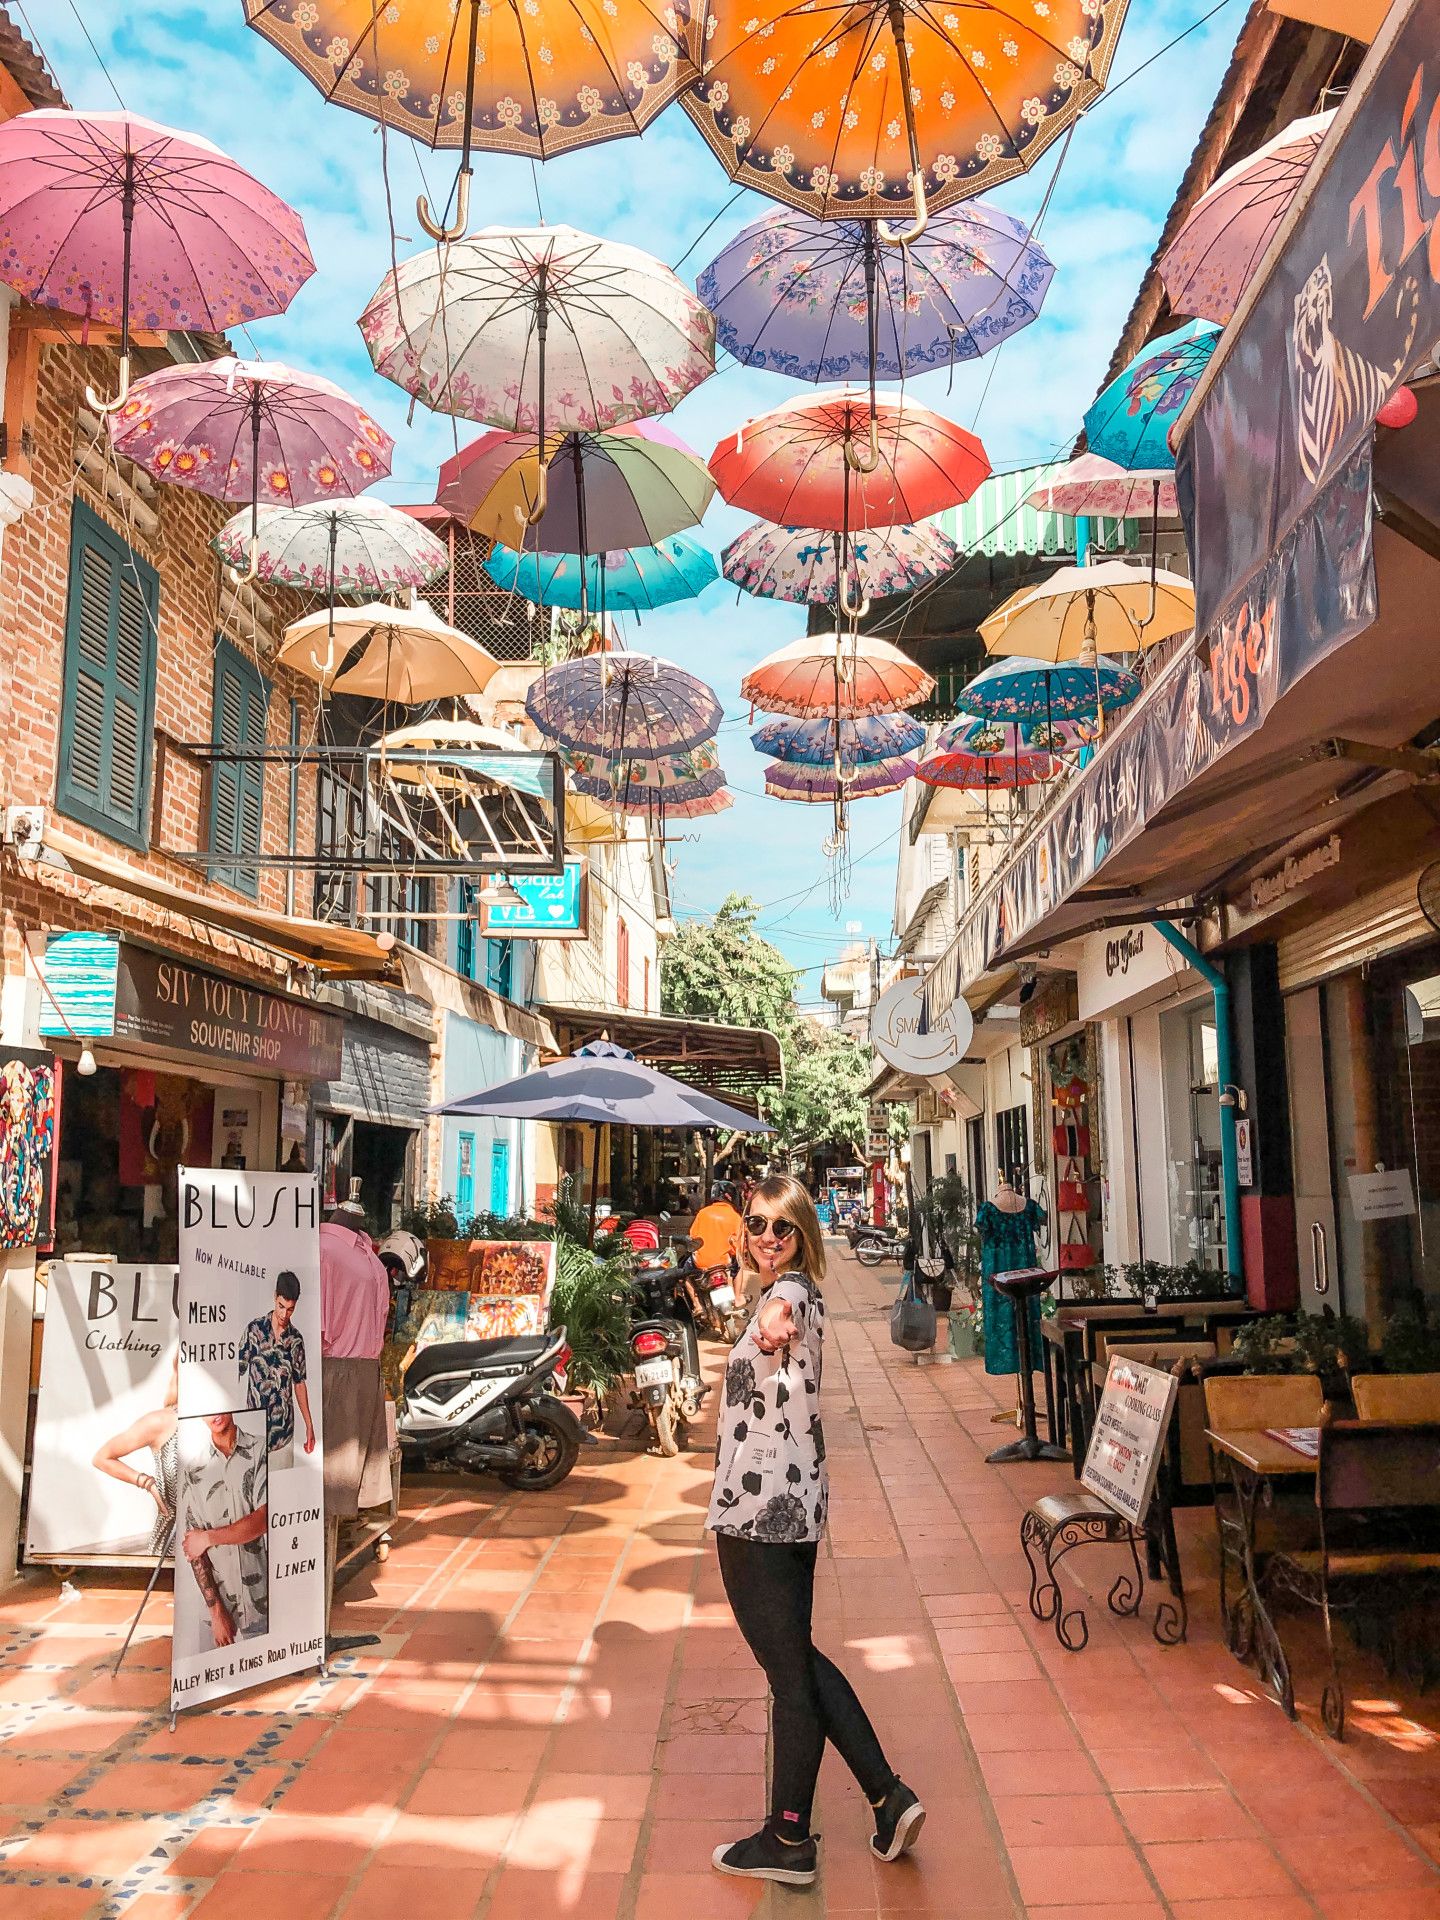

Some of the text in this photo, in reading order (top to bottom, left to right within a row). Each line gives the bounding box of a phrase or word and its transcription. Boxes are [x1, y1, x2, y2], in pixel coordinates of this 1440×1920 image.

[1346, 60, 1440, 324] Ti
[156, 963, 196, 1007] SIV
[257, 995, 304, 1036] LONG
[896, 1017, 952, 1033] SMARIA
[190, 1020, 250, 1055] SOUVENIR
[252, 1036, 281, 1060] SHOP
[184, 1183, 315, 1229] BLUSH
[85, 1329, 162, 1358] Clothing
[1124, 1395, 1147, 1415] COOKING
[1145, 1404, 1162, 1422] CLASS
[291, 1536, 299, 1550] &
[229, 1664, 235, 1676] &
